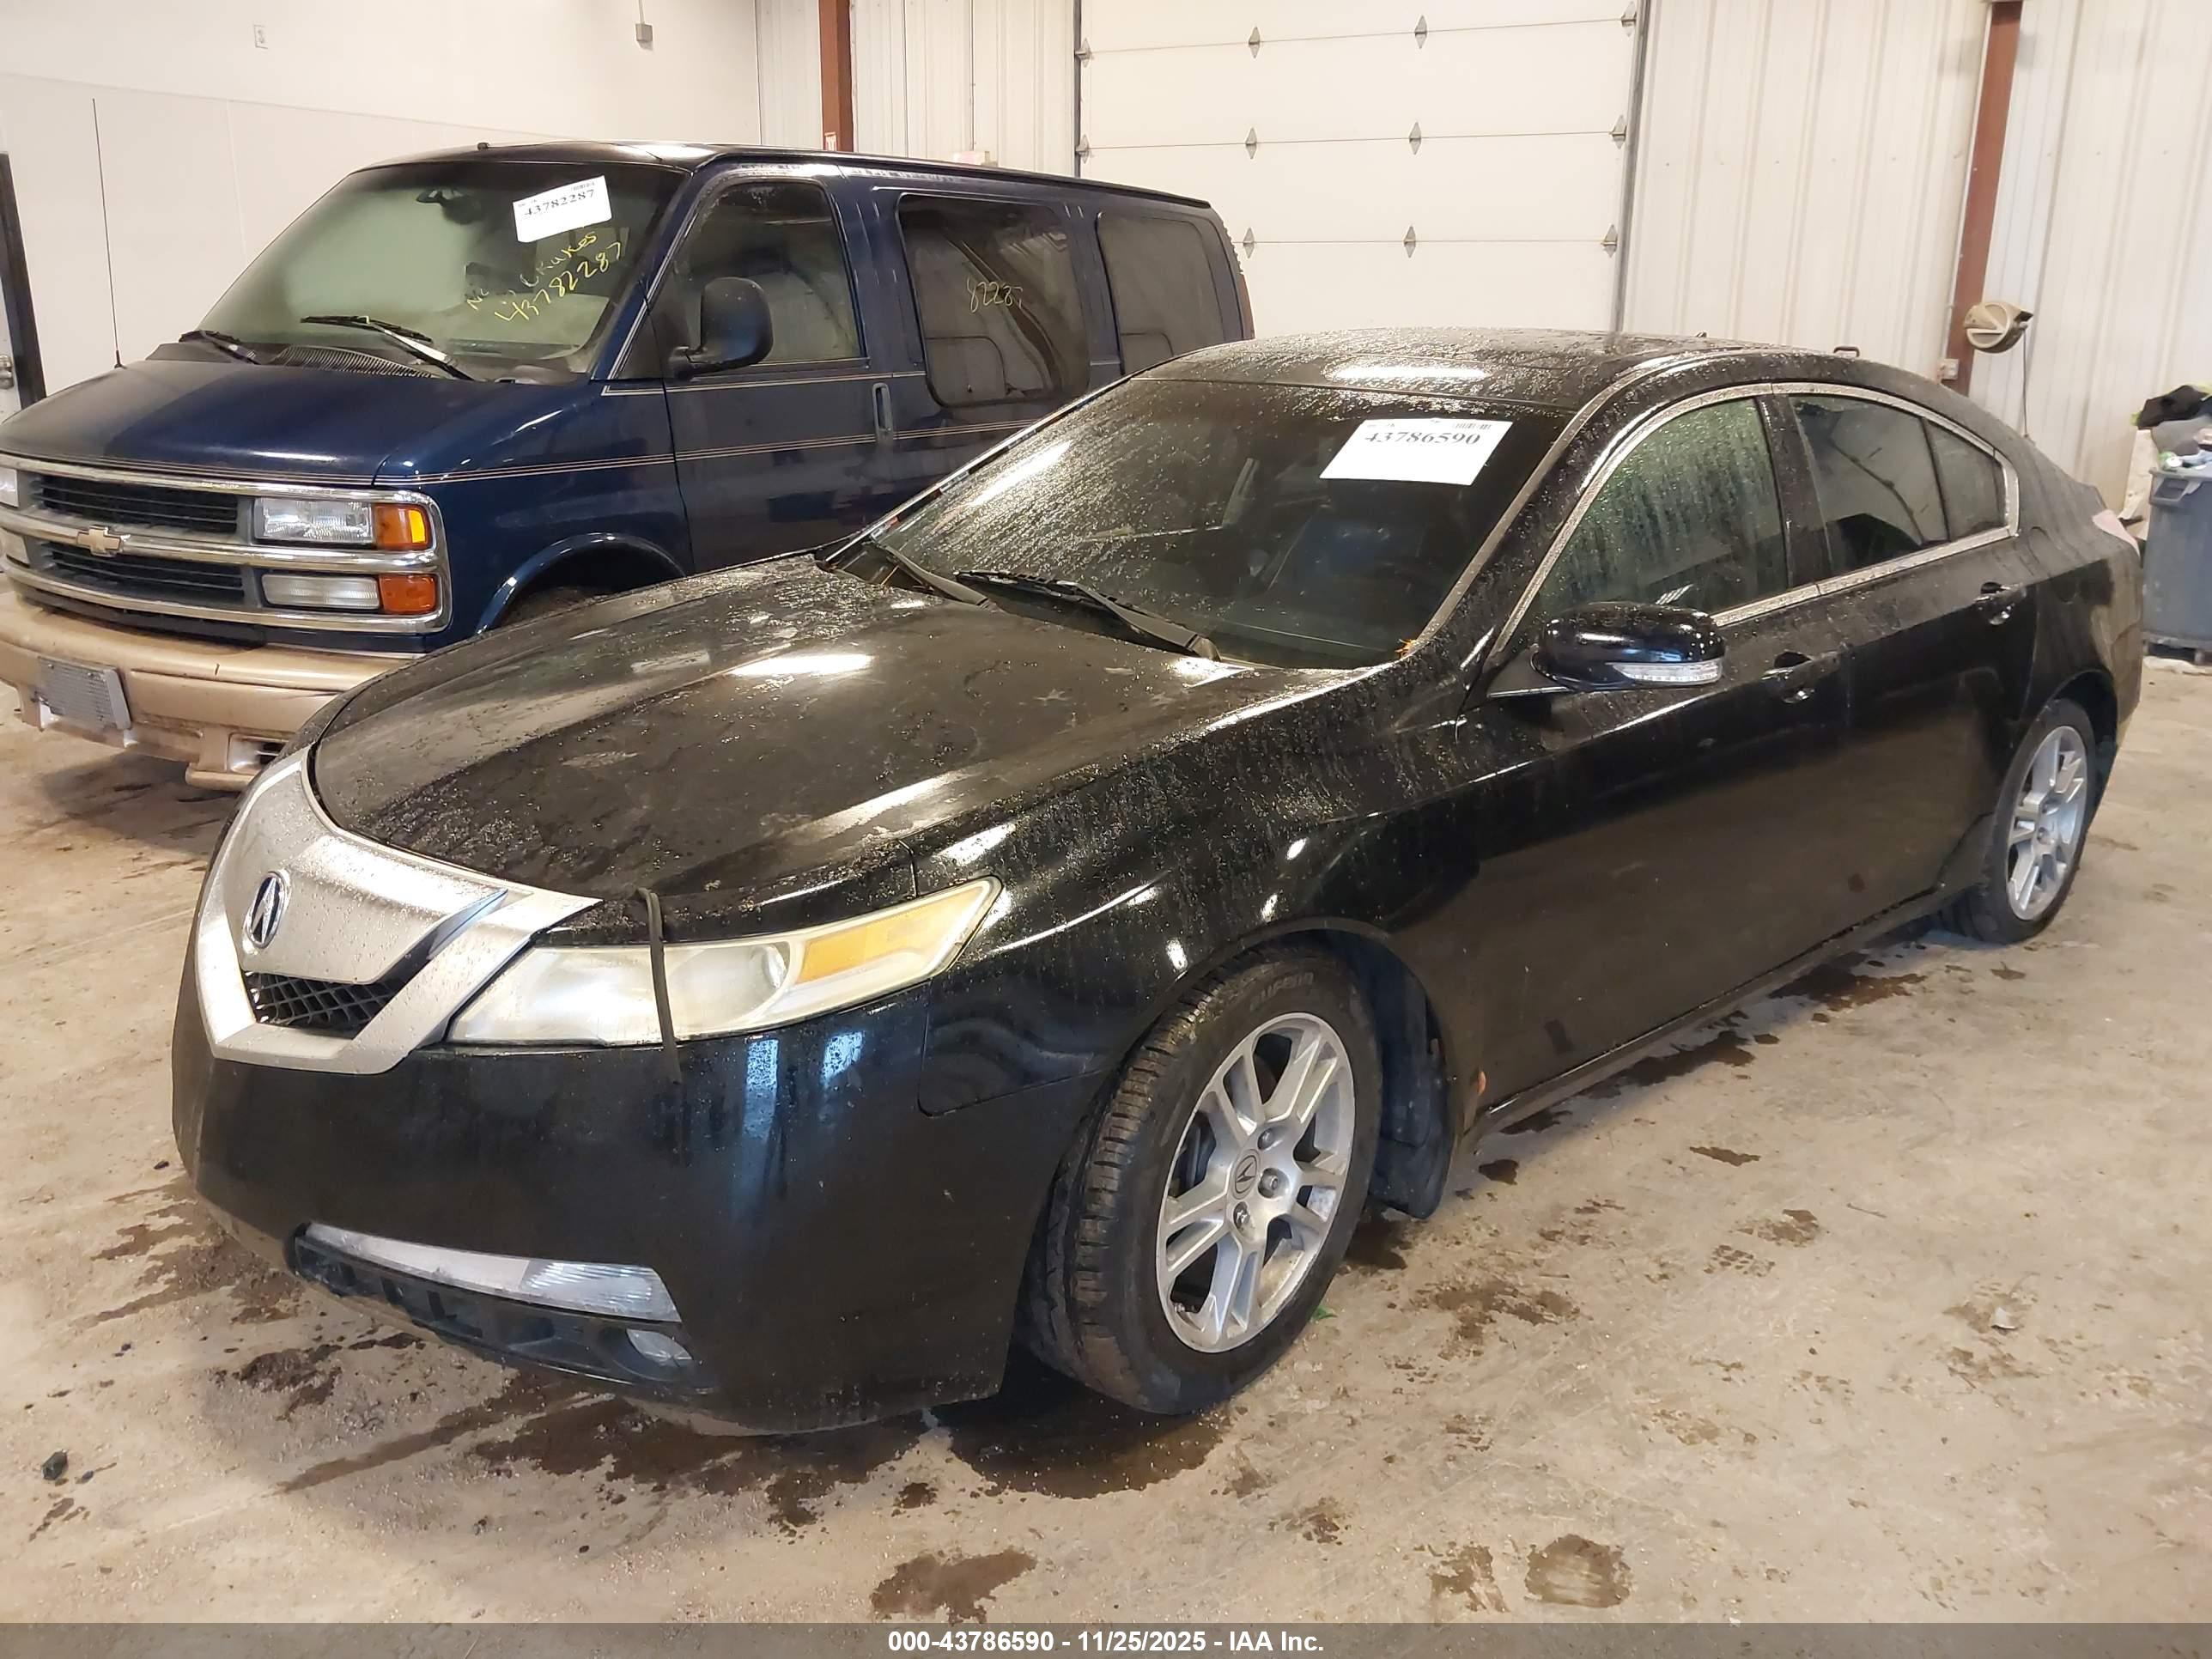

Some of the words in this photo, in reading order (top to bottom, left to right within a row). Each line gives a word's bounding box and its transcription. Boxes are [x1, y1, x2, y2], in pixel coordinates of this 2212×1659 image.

[524, 188, 595, 216] 43782287
[494, 240, 622, 322] 43782287
[1364, 431, 1481, 446] 43786590
